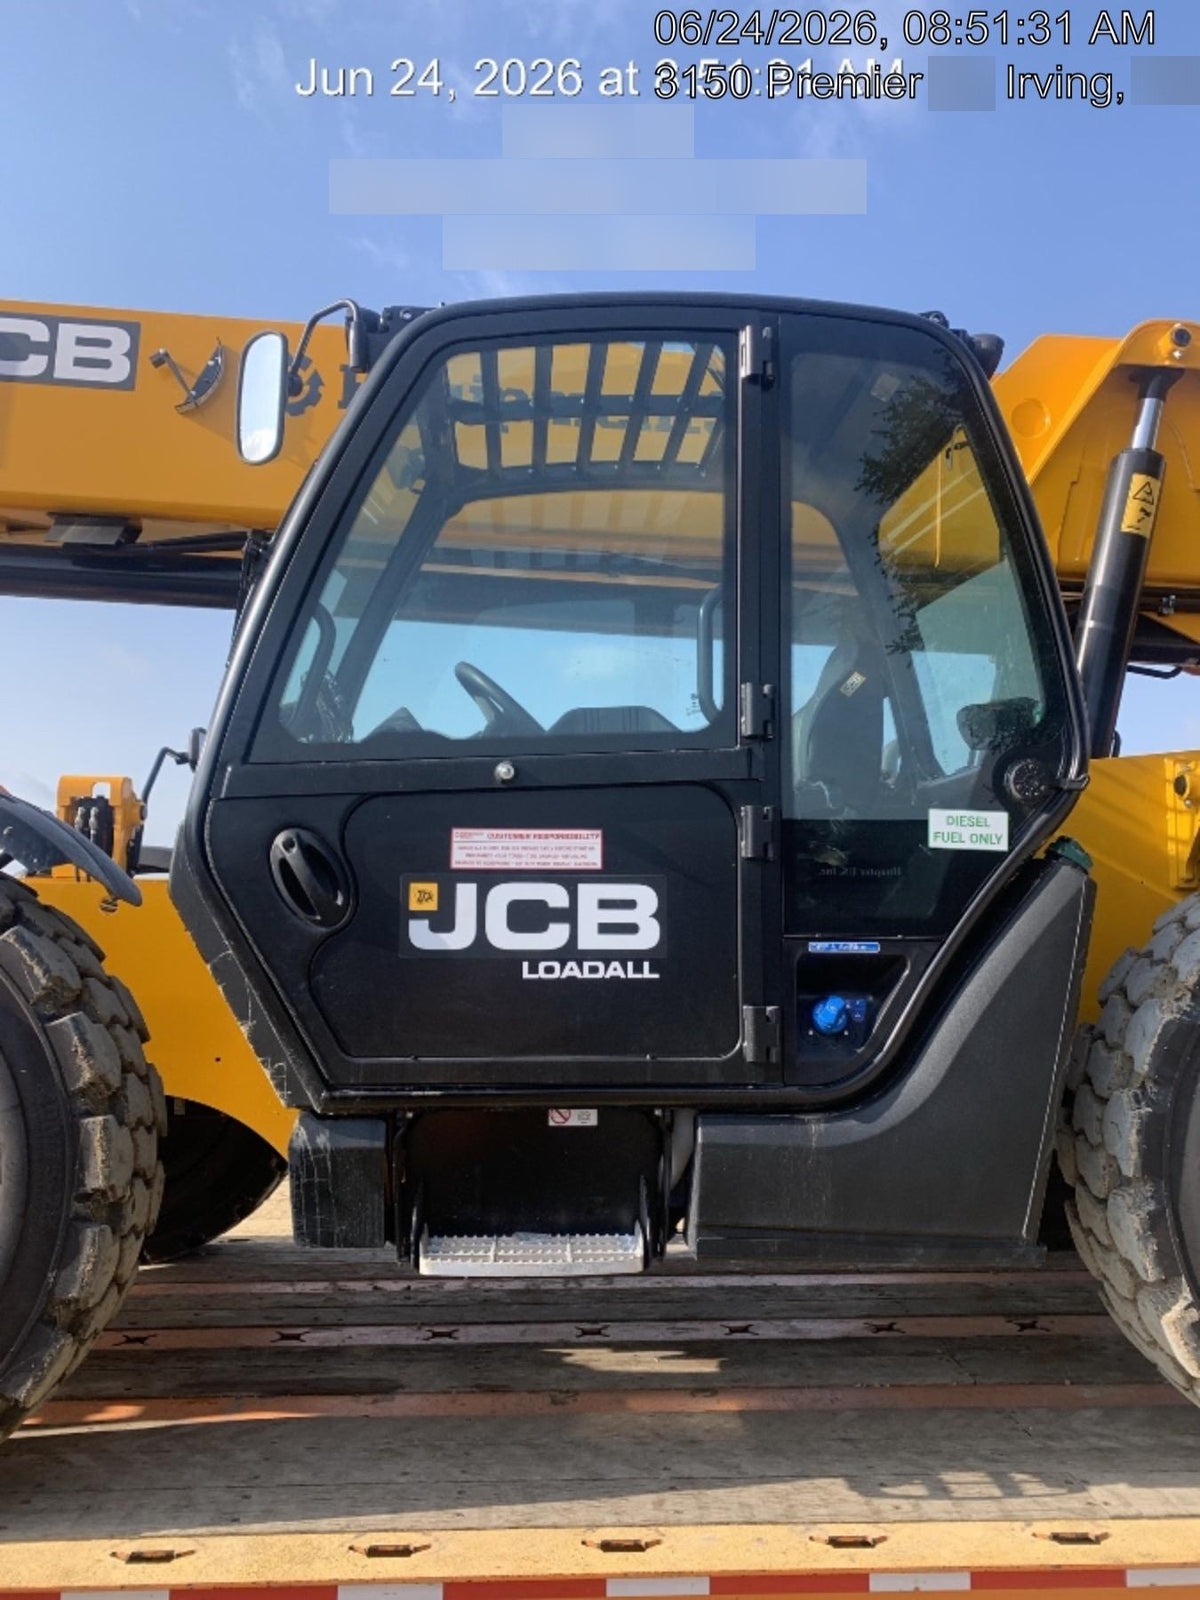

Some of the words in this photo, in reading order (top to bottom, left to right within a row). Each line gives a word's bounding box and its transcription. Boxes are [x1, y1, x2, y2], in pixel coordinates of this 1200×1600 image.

[946, 815, 990, 828] DIESEL
[933, 831, 965, 844] FUEL
[969, 832, 1003, 845] ONLY
[408, 881, 660, 951] JCB
[522, 961, 660, 979] LOADALL
